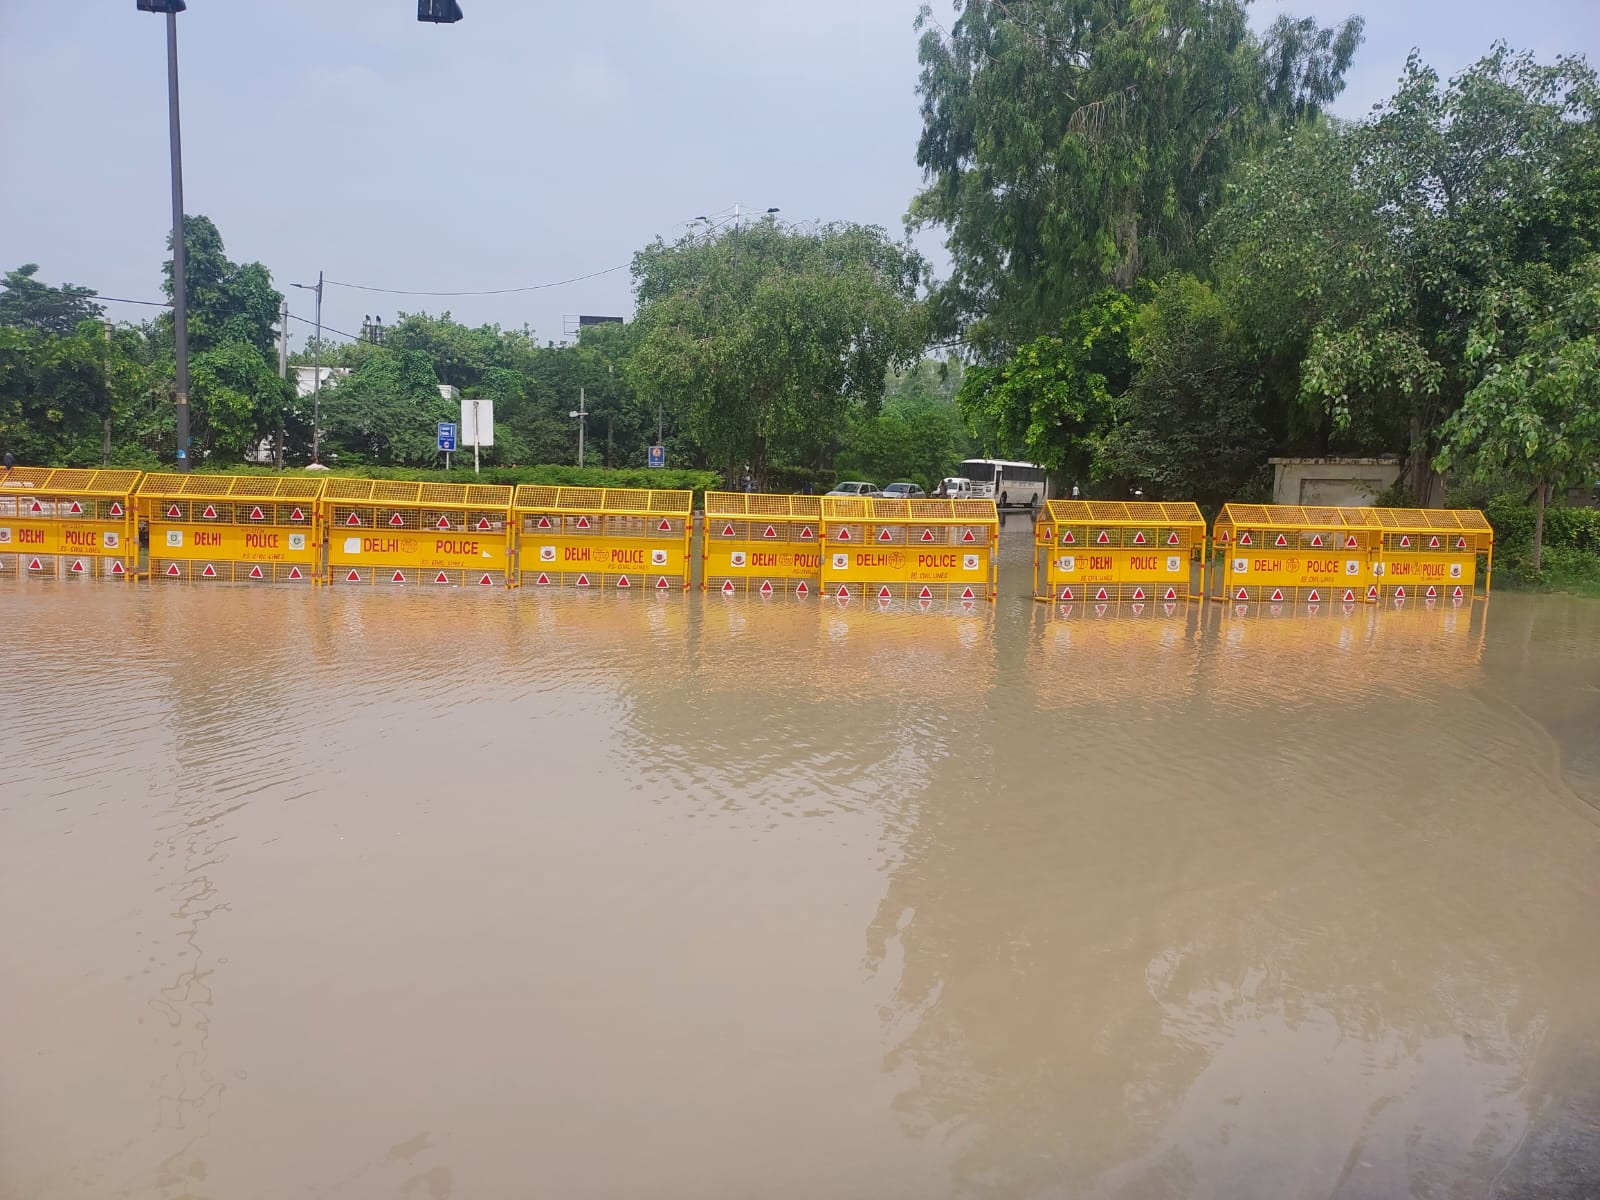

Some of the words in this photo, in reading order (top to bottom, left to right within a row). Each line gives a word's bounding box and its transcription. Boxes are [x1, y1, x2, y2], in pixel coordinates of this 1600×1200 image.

[19, 529, 45, 544] DELHI
[65, 530, 97, 546] POLICE
[194, 531, 222, 546] DELHI
[246, 533, 279, 548] POLICE
[363, 537, 399, 552] DELHI
[435, 539, 479, 555] POLICE
[564, 547, 591, 561] DELHI
[611, 549, 644, 564] POLICE
[751, 553, 777, 566] DELHI
[794, 554, 819, 568] POLIC
[856, 553, 888, 566] DELHI
[918, 554, 957, 568] POLICE
[1089, 556, 1113, 570] DELHI
[1130, 556, 1158, 570] POLICE
[1254, 559, 1282, 572] DELHI
[1307, 560, 1339, 573] POLICE
[1391, 562, 1411, 575] DELHI
[1422, 563, 1445, 576] POLICE
